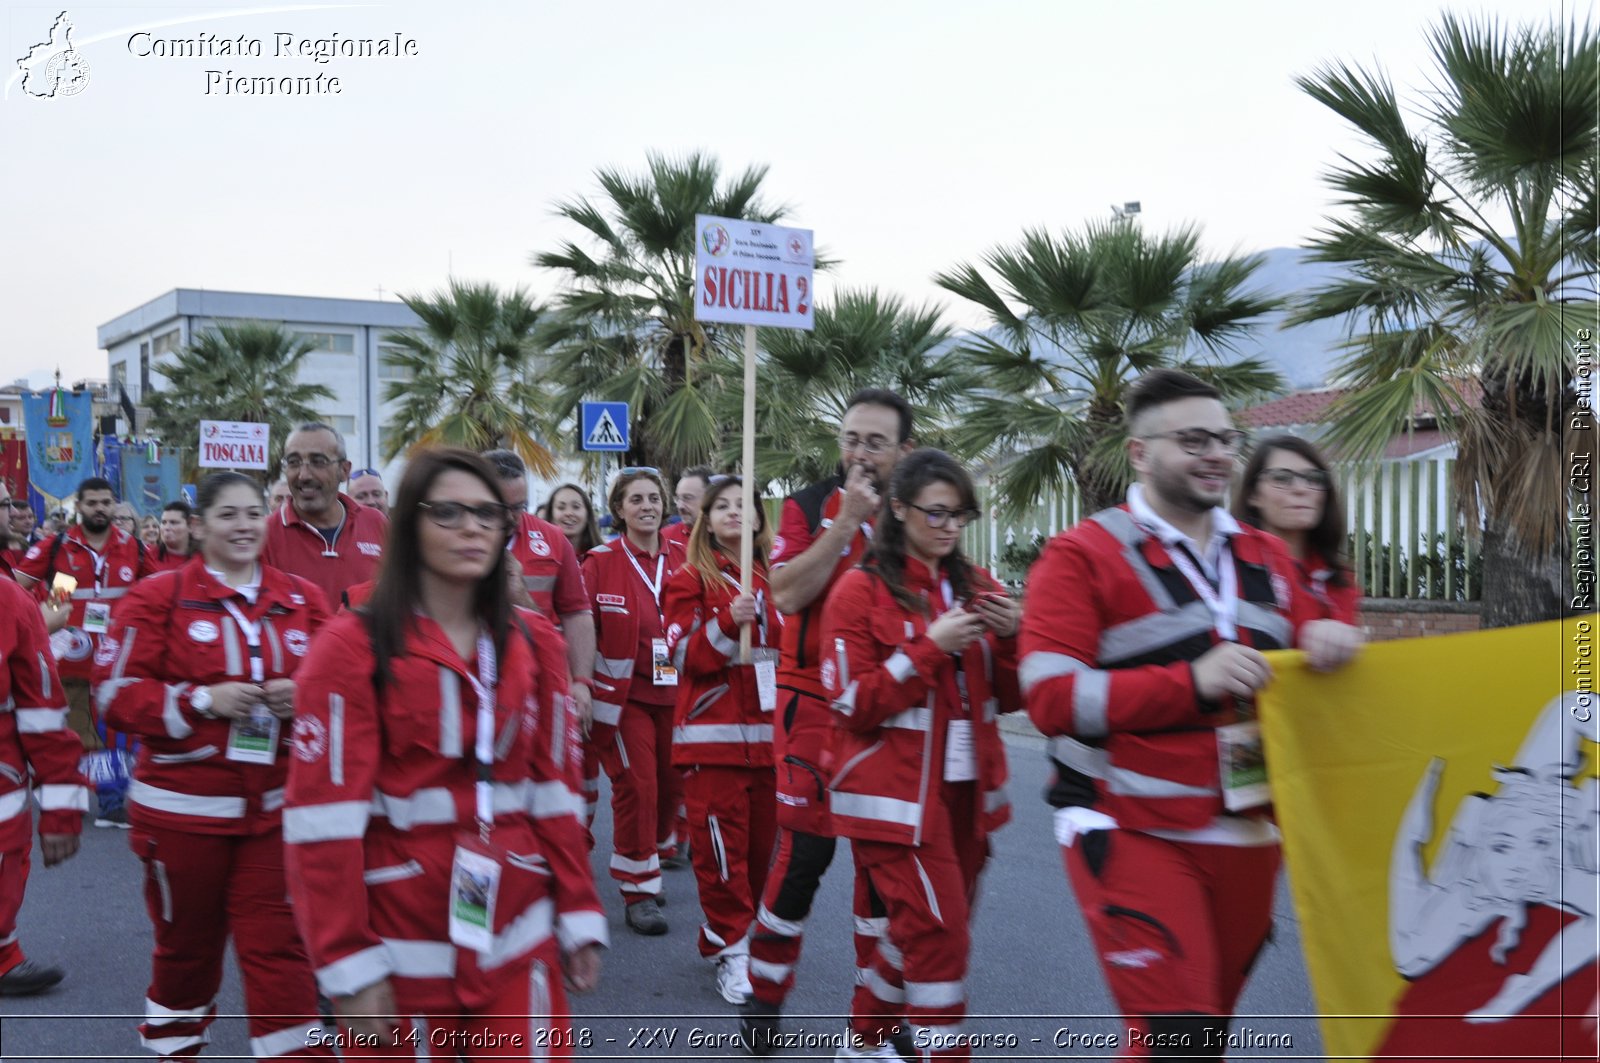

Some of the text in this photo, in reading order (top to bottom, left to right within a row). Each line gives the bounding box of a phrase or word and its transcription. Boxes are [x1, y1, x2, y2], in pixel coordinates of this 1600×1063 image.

[703, 265, 809, 315] SICILIA 2
[204, 442, 265, 464] TOSCANA
